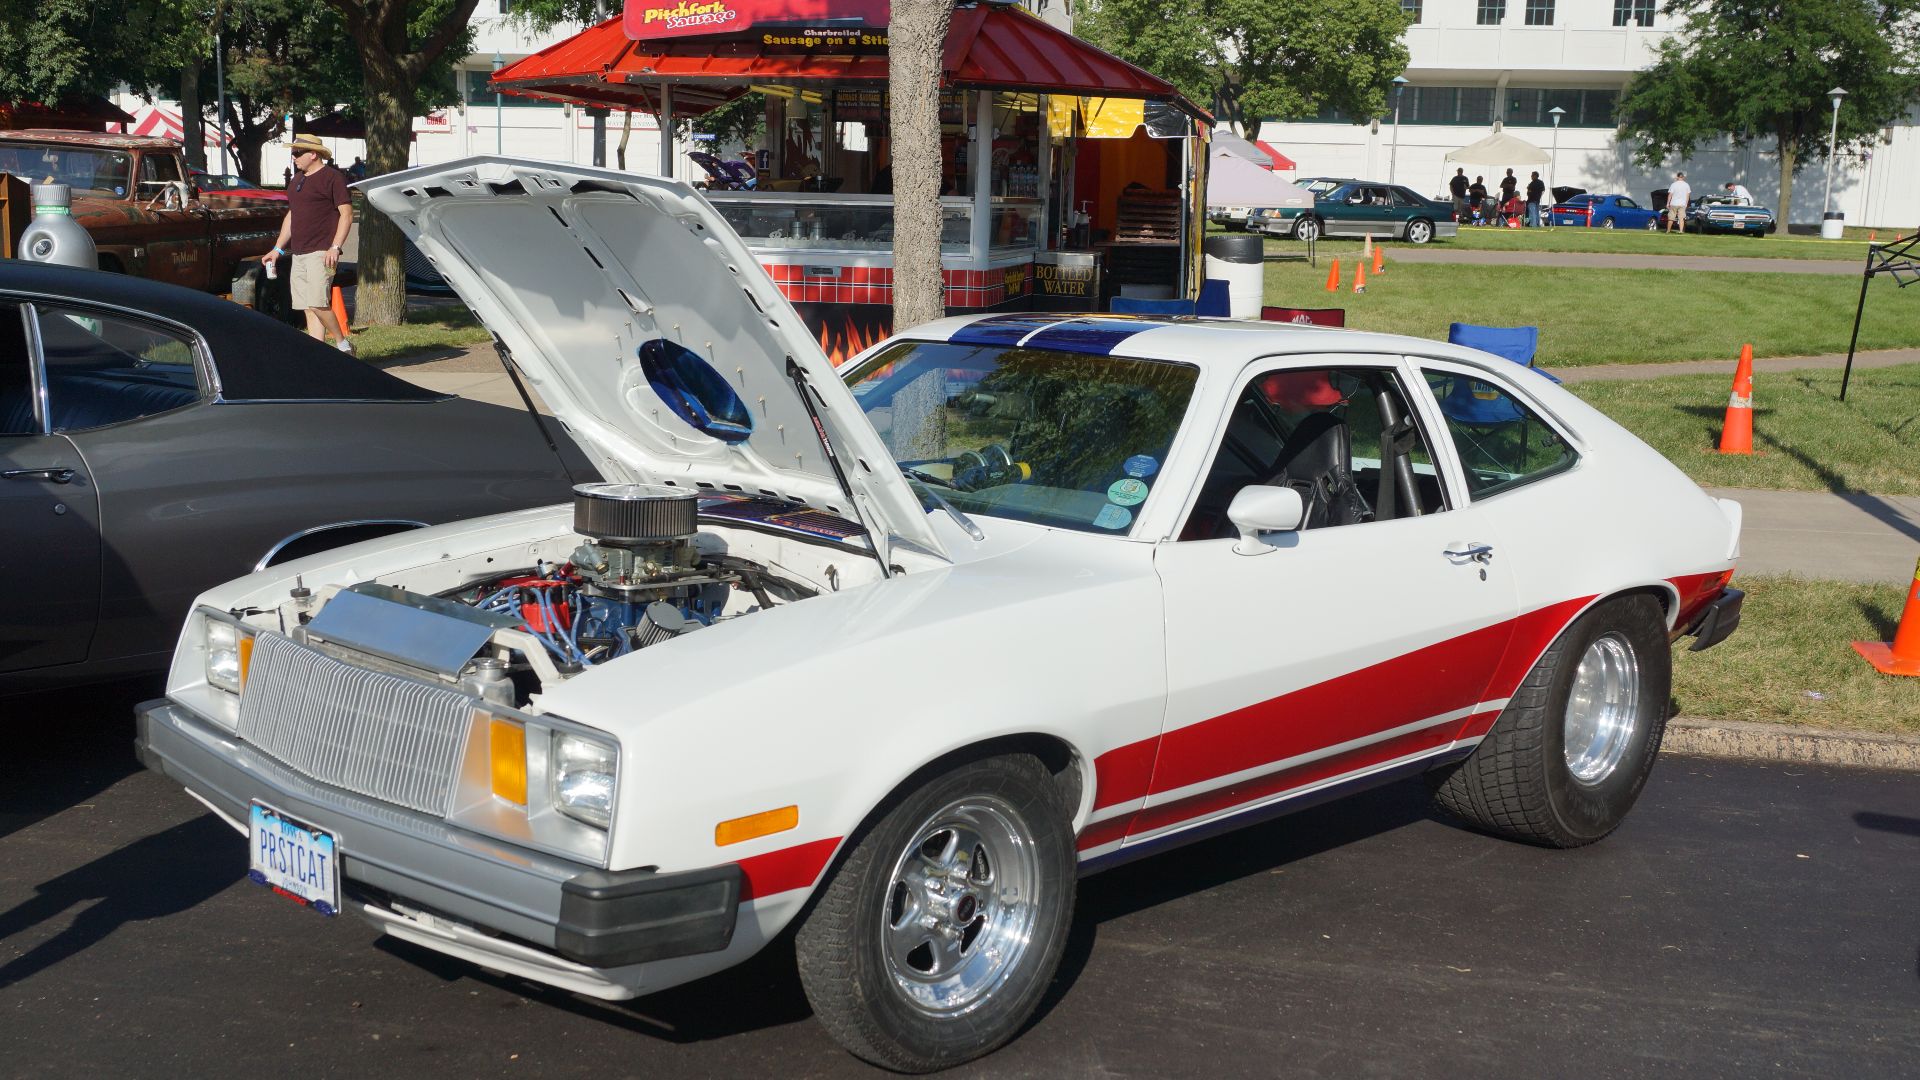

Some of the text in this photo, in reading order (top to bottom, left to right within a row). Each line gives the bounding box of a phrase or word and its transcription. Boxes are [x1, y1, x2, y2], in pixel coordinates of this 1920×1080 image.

[644, 1, 725, 23] Pitchfork
[667, 10, 736, 28] Sausage
[763, 34, 888, 47] Sausage on a Stic
[1036, 266, 1093, 281] BOTTLED
[1044, 280, 1085, 295] WATER
[260, 828, 326, 891] PRSTCAT
